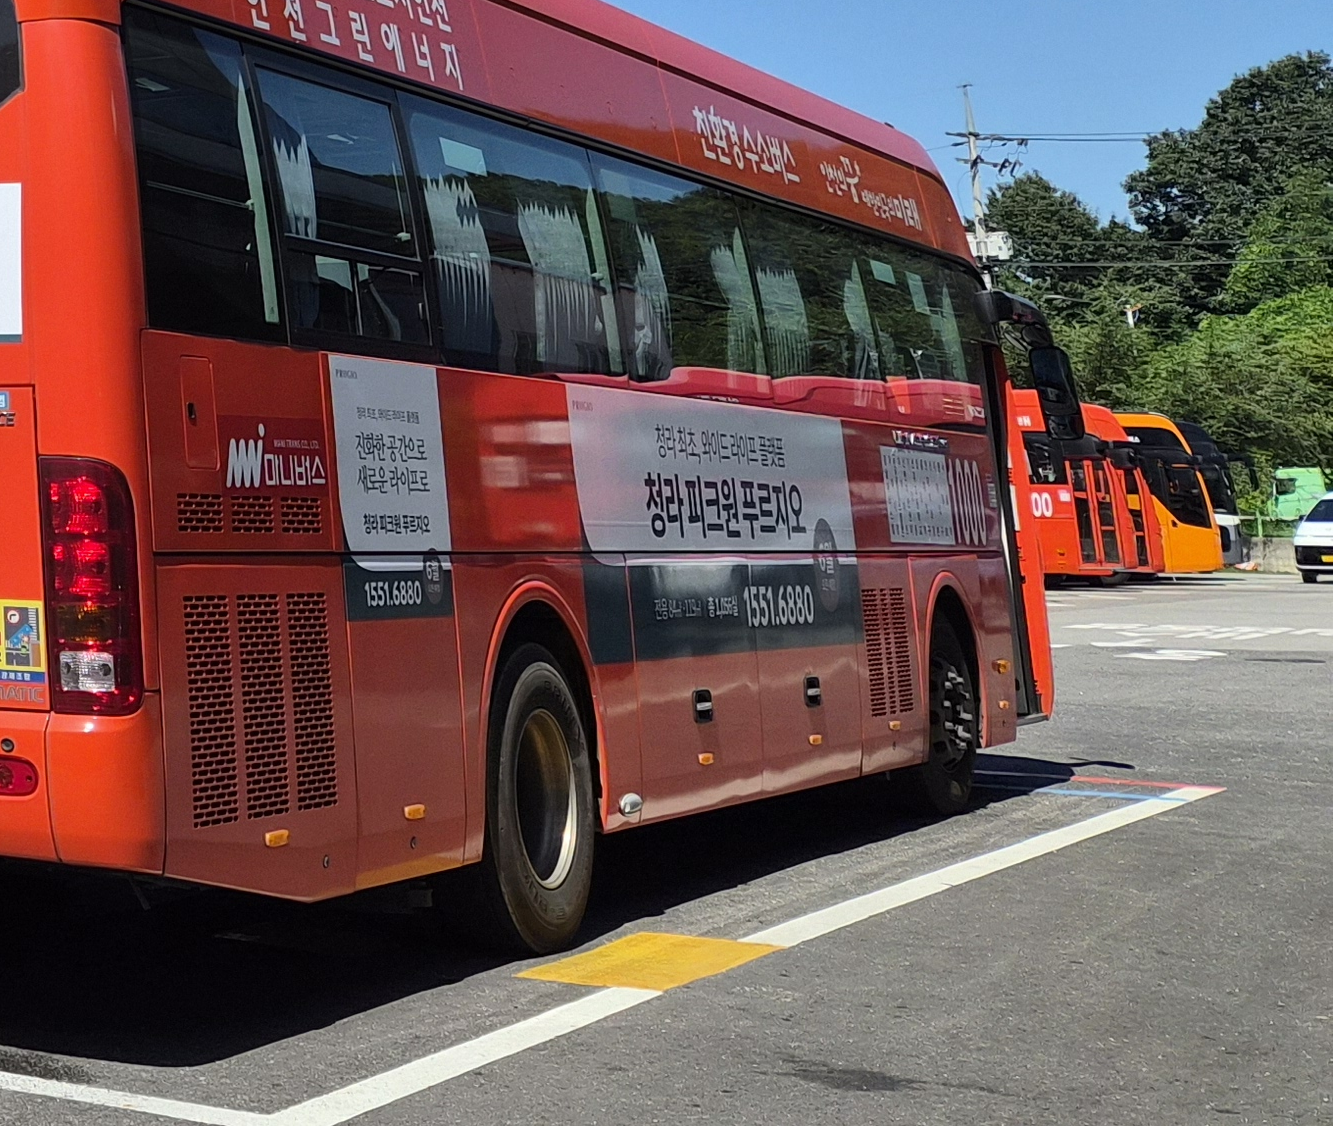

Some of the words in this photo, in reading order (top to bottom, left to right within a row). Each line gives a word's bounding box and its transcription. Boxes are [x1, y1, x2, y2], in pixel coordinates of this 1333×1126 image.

[355, 431, 386, 462] 진화한
[387, 435, 427, 462] 공간으로
[655, 424, 677, 459] 청라
[701, 430, 730, 463] 와이드
[730, 433, 759, 465] 라이프
[264, 454, 326, 486] 마니버스
[357, 464, 388, 495] 새로운
[389, 467, 431, 495] 라이프로
[644, 472, 684, 538] 청라
[685, 475, 741, 538] 피크원
[740, 480, 807, 540] 푸르지오
[948, 458, 986, 546] 1000
[363, 514, 380, 535] 청라
[402, 515, 431, 535] 푸르지오
[364, 580, 422, 607] 1551.6880
[743, 584, 814, 628] 1551.6880
